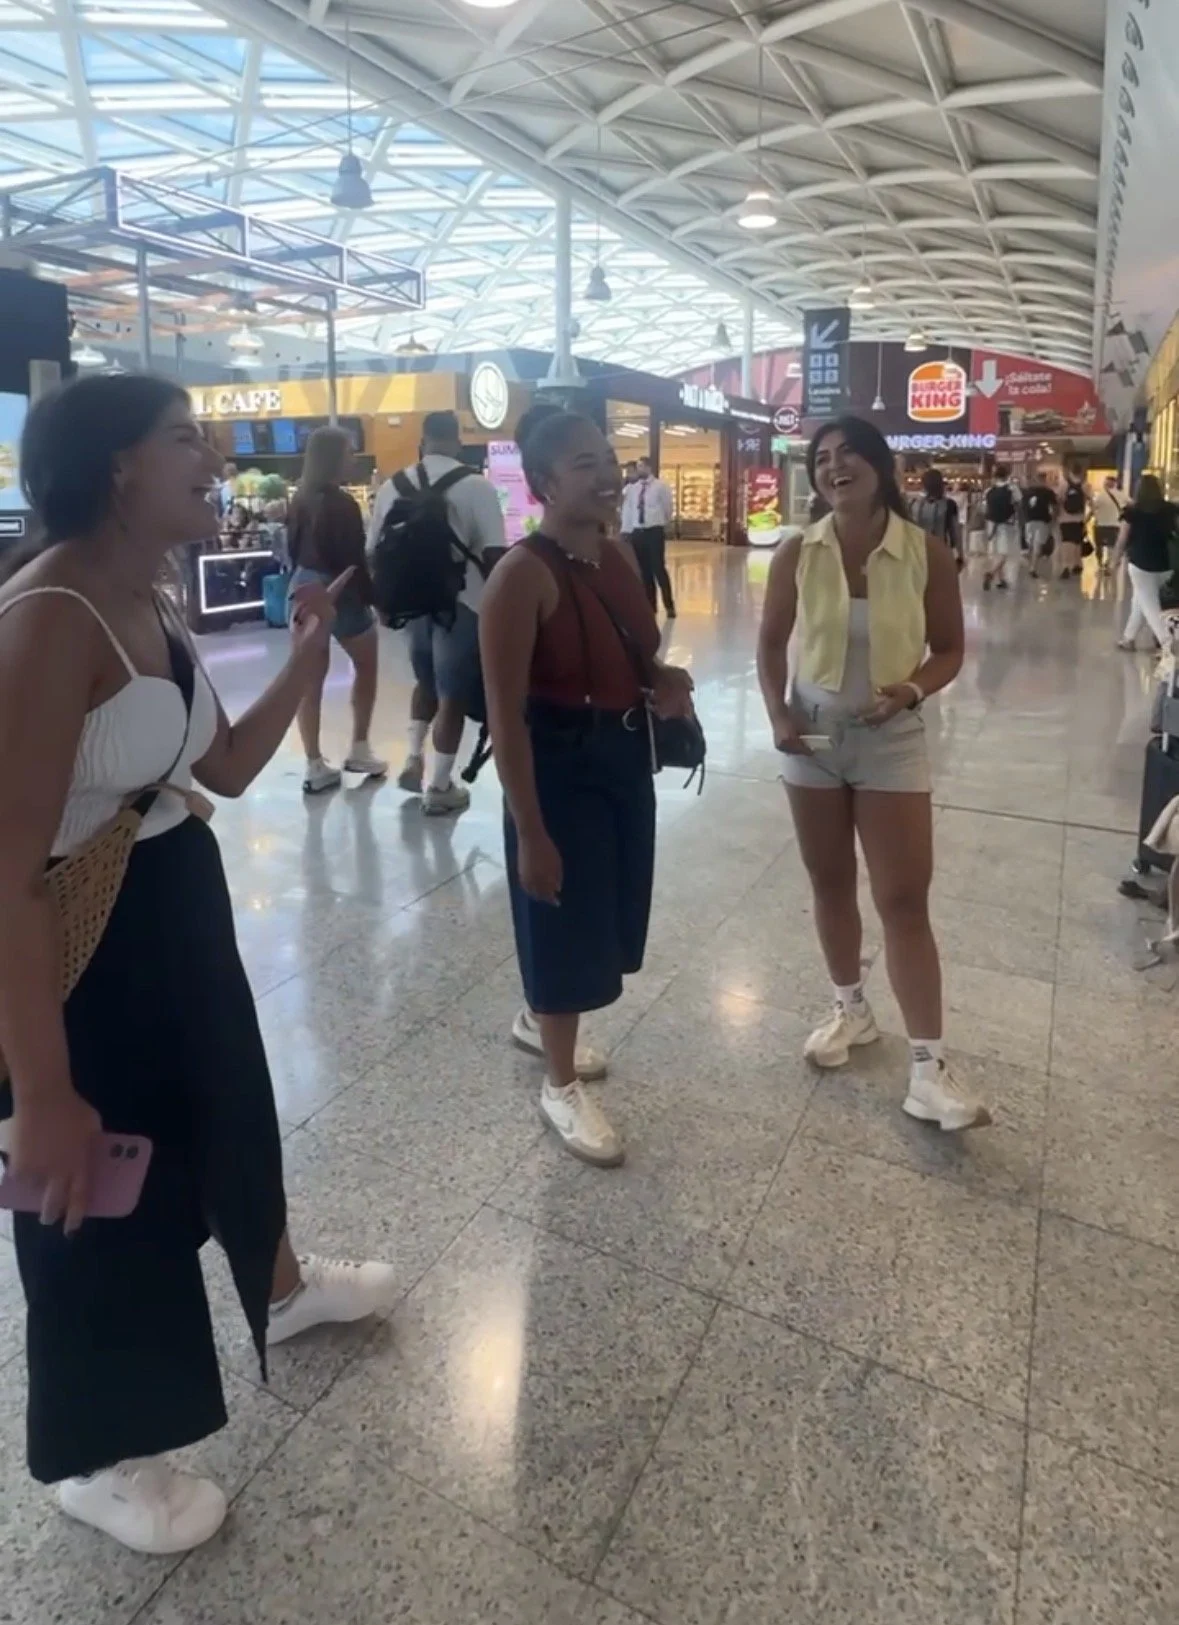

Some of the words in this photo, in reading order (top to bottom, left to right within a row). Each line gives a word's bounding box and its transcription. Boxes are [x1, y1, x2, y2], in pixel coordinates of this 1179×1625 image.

[911, 380, 962, 392] BURGER
[214, 389, 281, 414] CAFE
[911, 393, 961, 409] KING
[884, 434, 947, 450] URGER
[949, 434, 997, 448] KING
